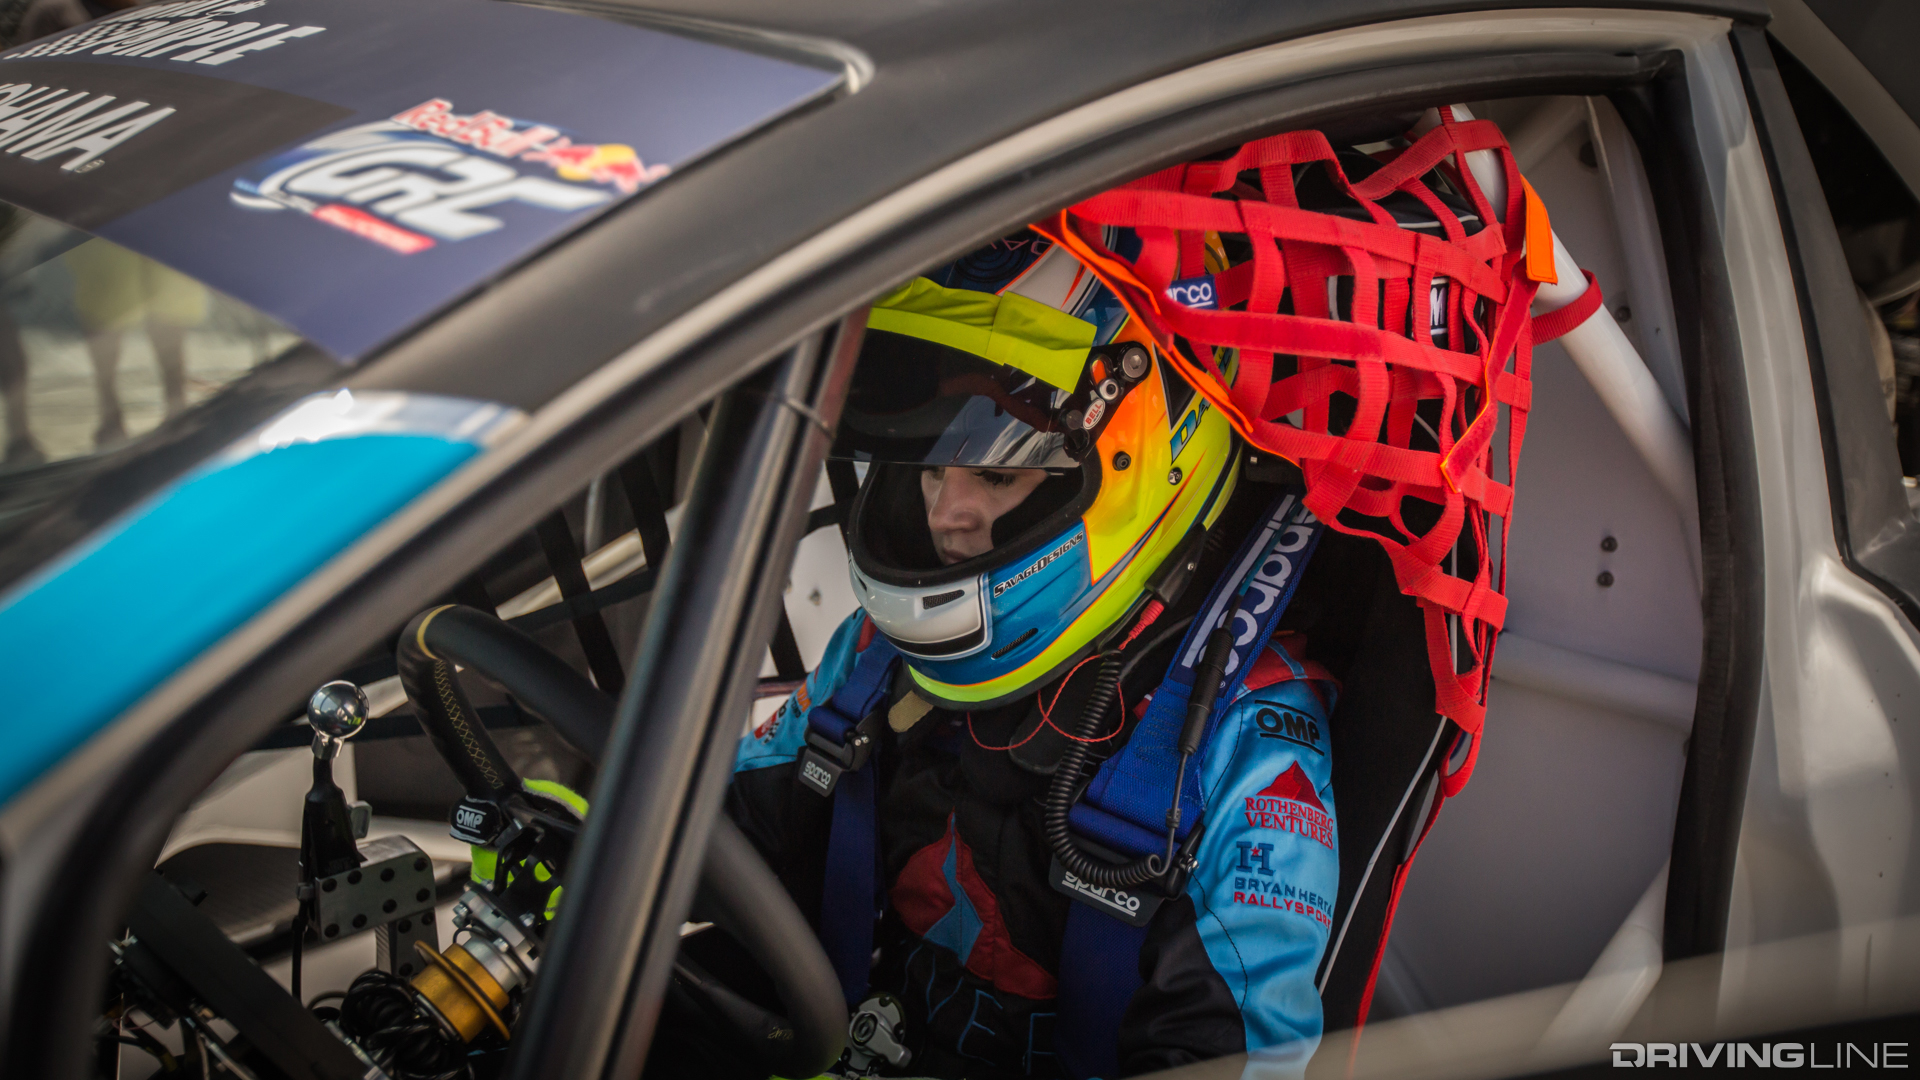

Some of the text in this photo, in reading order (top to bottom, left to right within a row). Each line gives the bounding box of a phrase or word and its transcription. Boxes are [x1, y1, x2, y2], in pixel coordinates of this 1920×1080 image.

[1085, 403, 1103, 425] BELL
[1256, 707, 1321, 746] OMP
[803, 760, 832, 786] sparco
[456, 809, 484, 829] OMP
[1244, 797, 1334, 832] ROTHENBERG
[1244, 812, 1333, 850] VENTURES
